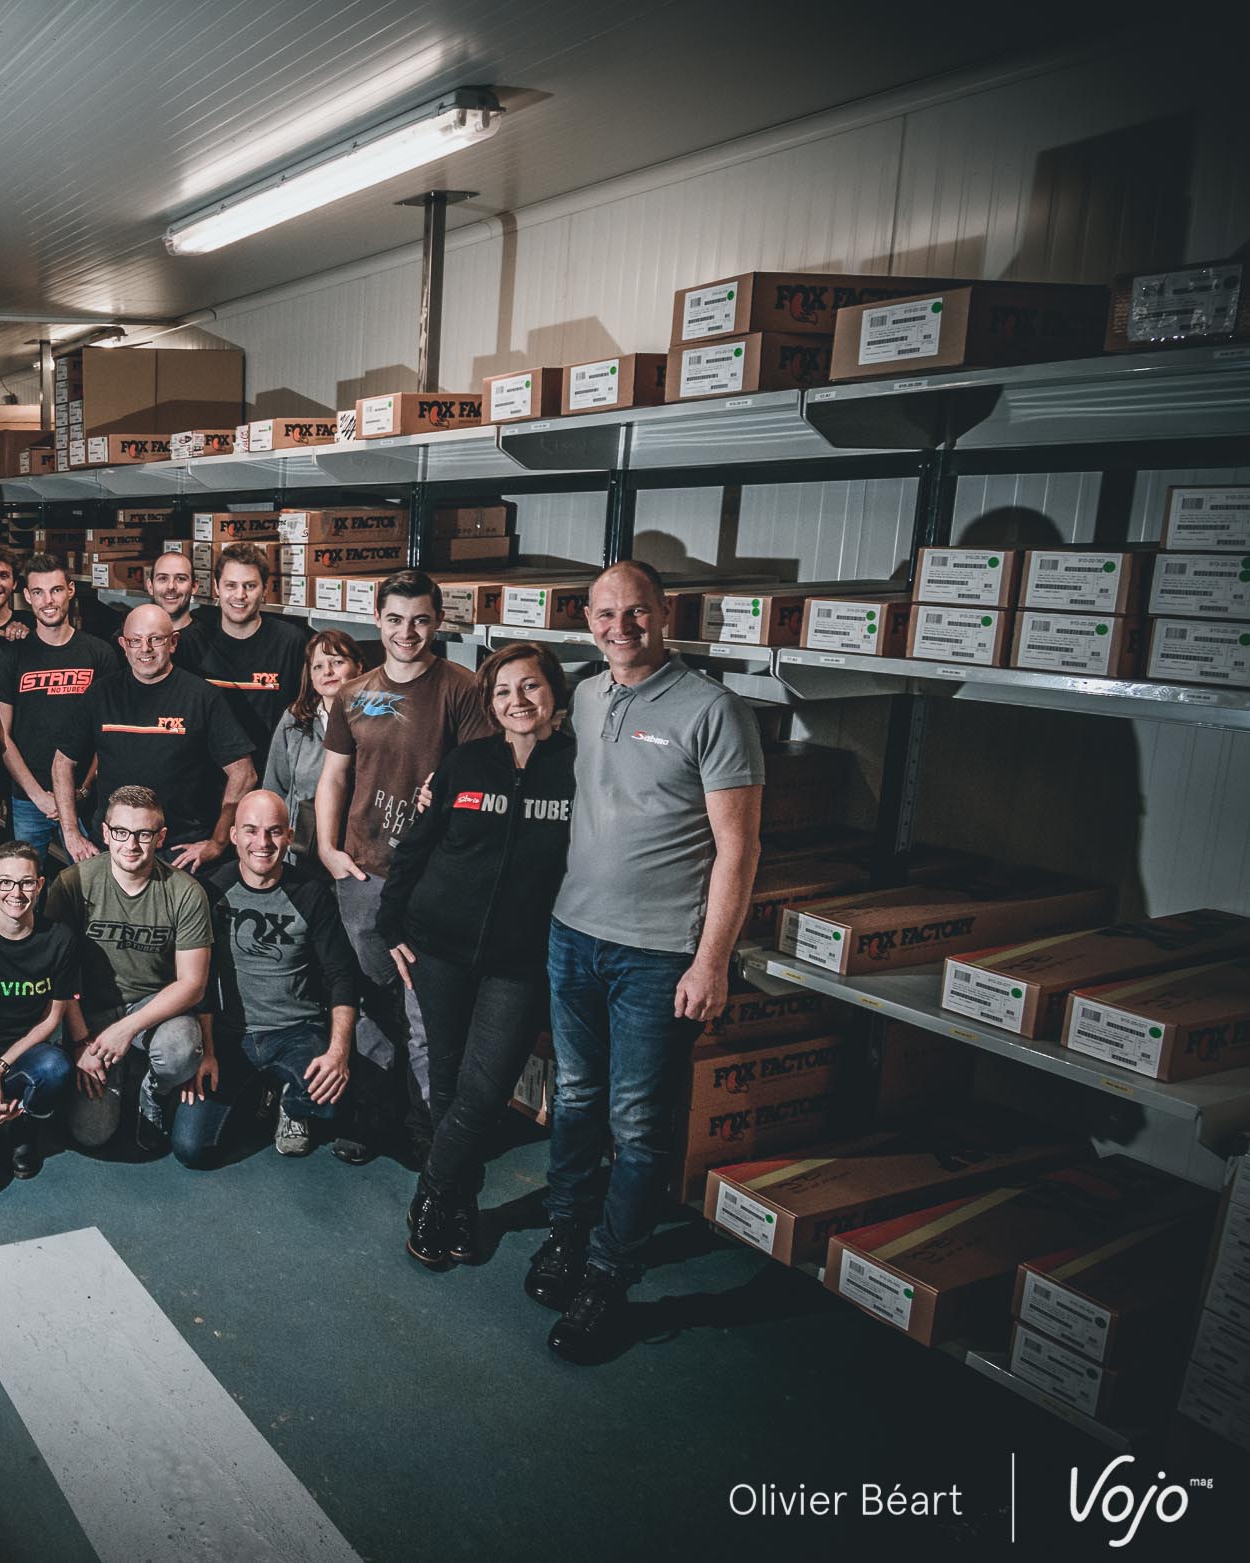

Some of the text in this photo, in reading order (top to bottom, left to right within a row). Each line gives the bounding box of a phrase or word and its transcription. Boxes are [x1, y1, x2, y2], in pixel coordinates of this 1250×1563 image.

[774, 284, 827, 318] FOX
[418, 400, 456, 424] FOX
[205, 434, 230, 449] FOX
[284, 423, 313, 441] FOX
[121, 440, 148, 456] FOX
[220, 520, 246, 535] FOX
[314, 546, 401, 565] FOX FACTORY
[252, 672, 278, 686] FOX
[158, 717, 184, 730] FOX
[481, 793, 508, 814] NO
[857, 917, 976, 958] FOX FACTORY
[713, 1060, 757, 1090] FOX
[708, 1108, 752, 1139] FOX
